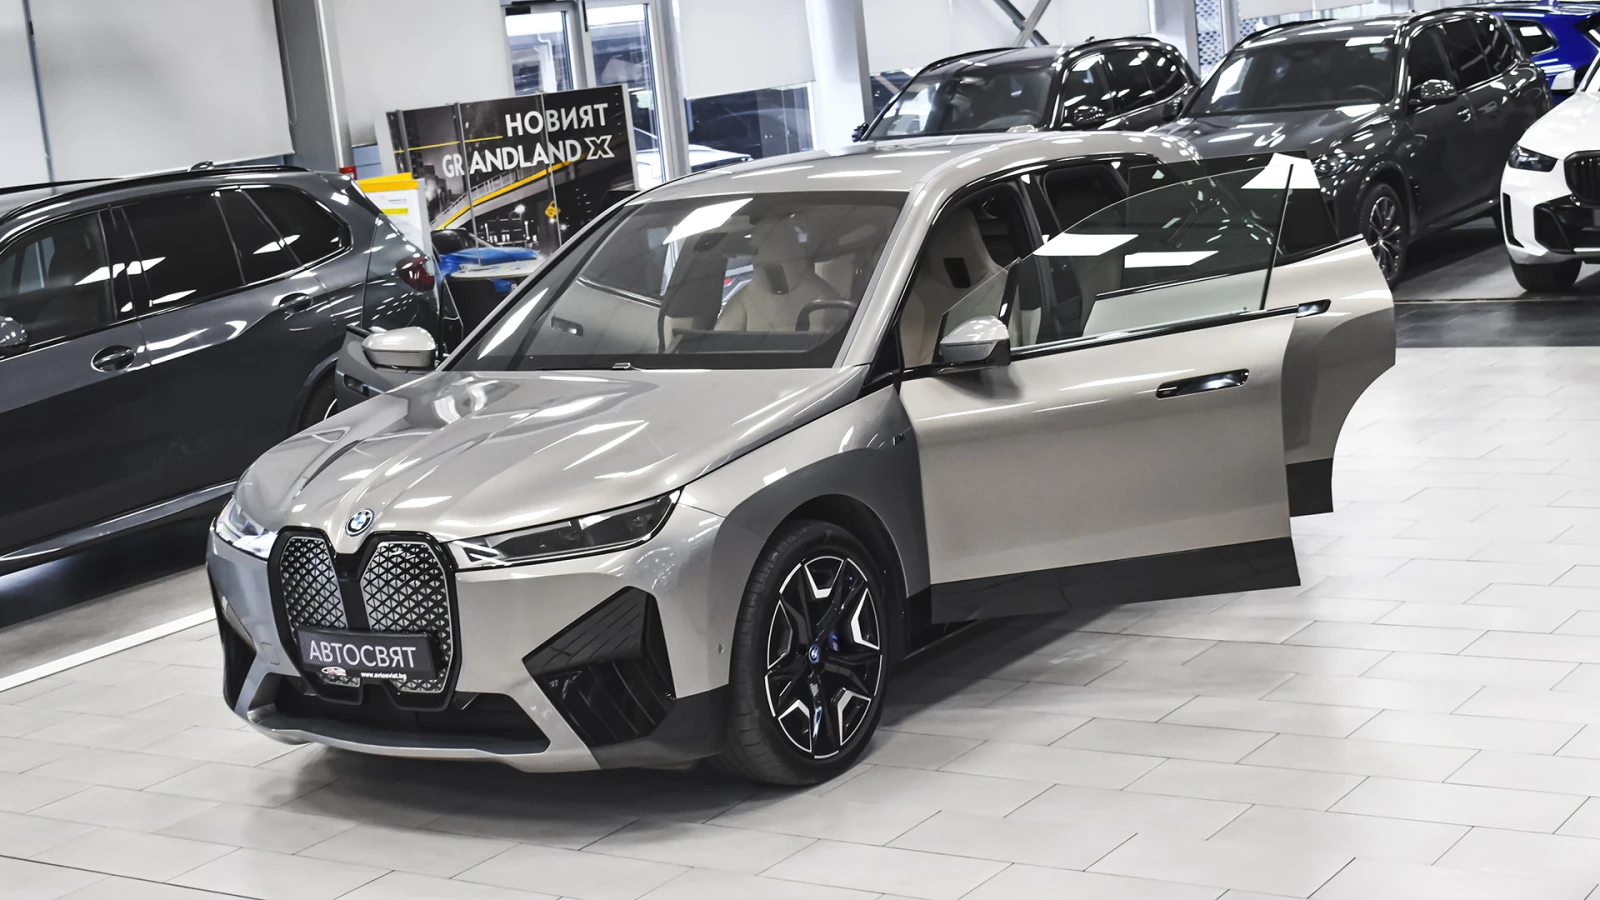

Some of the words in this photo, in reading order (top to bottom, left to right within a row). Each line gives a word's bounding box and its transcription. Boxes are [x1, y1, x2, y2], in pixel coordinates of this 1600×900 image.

[505, 103, 608, 137] НОВИЯТ
[442, 140, 582, 178] GRANDLAND
[584, 134, 615, 160] X
[309, 640, 416, 668] АВТОСВЯТ
